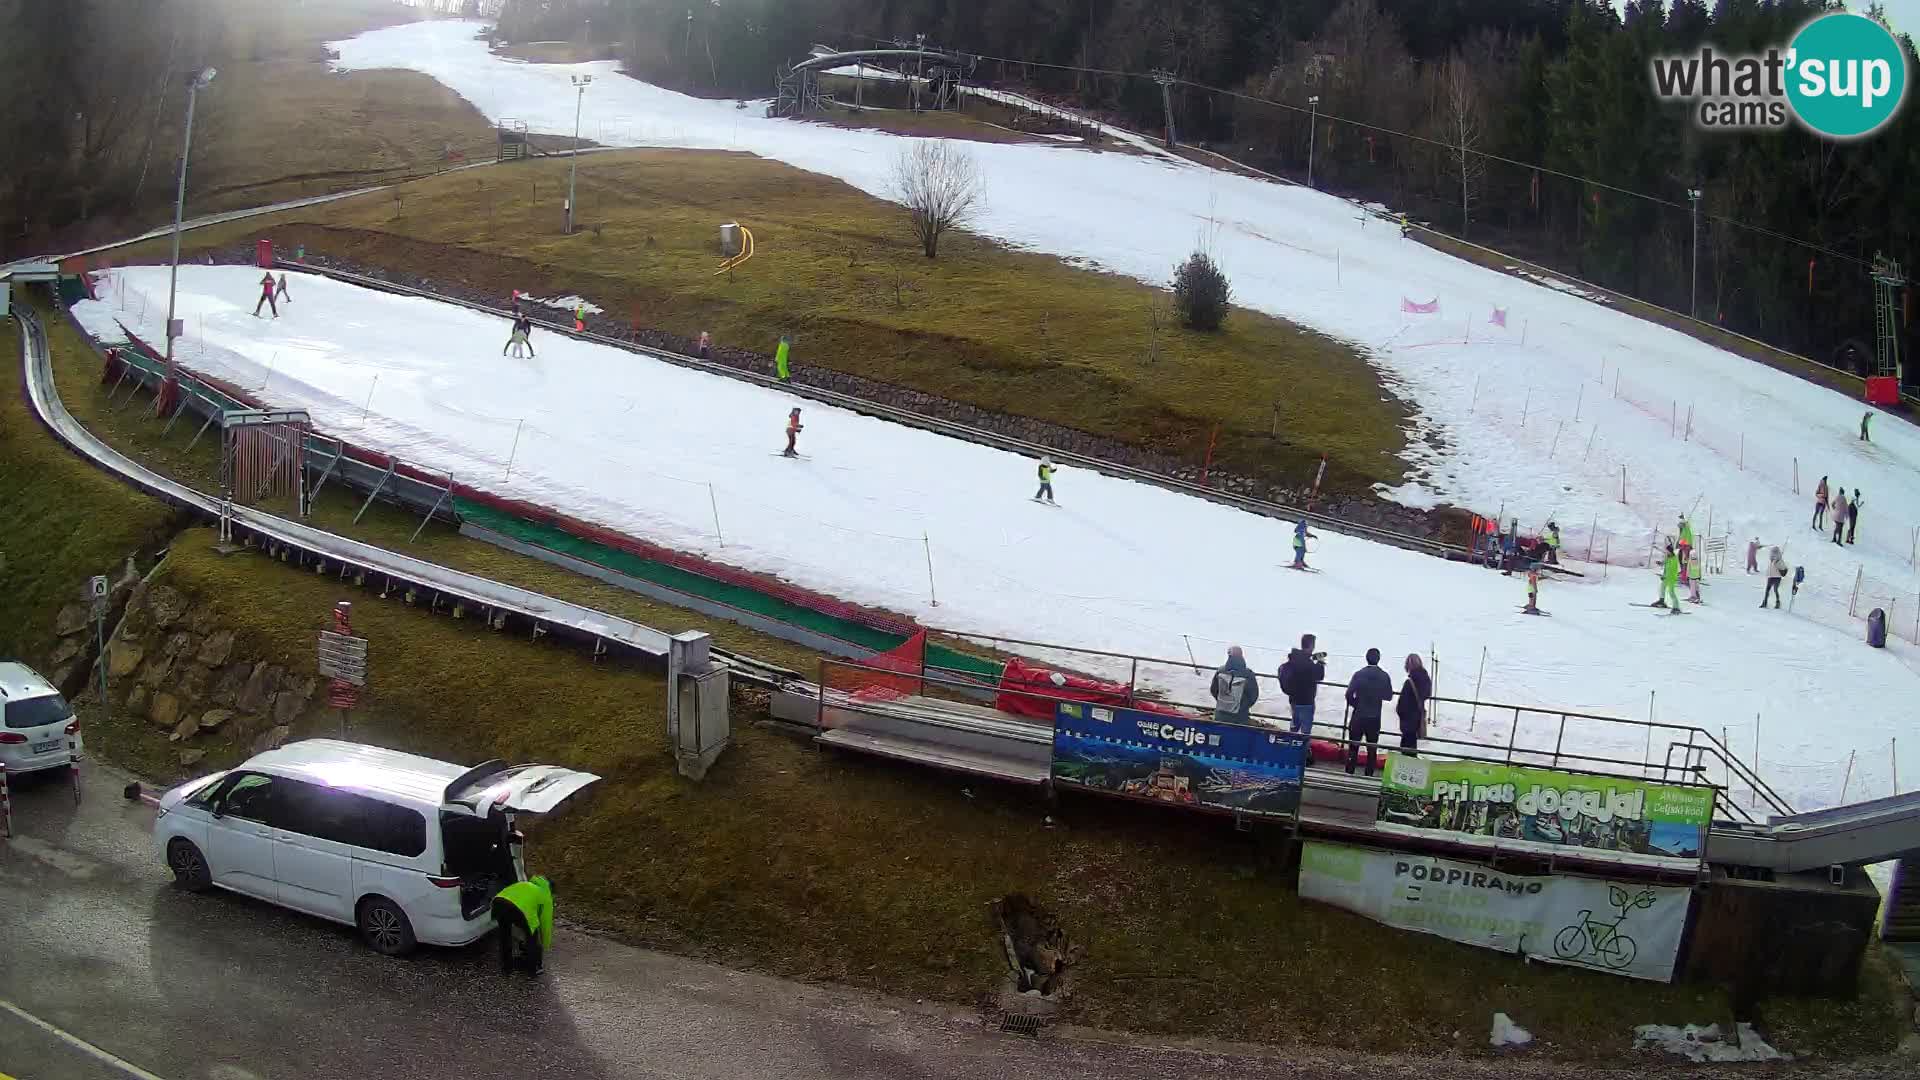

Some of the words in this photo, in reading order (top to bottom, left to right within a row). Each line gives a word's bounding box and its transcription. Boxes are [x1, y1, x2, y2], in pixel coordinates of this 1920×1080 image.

[1160, 724, 1206, 746] Celje
[1432, 779, 1469, 801] Pri
[1473, 783, 1515, 803] nas
[1516, 784, 1644, 823] dogaja!
[1395, 861, 1544, 896] PODPIRAMO
